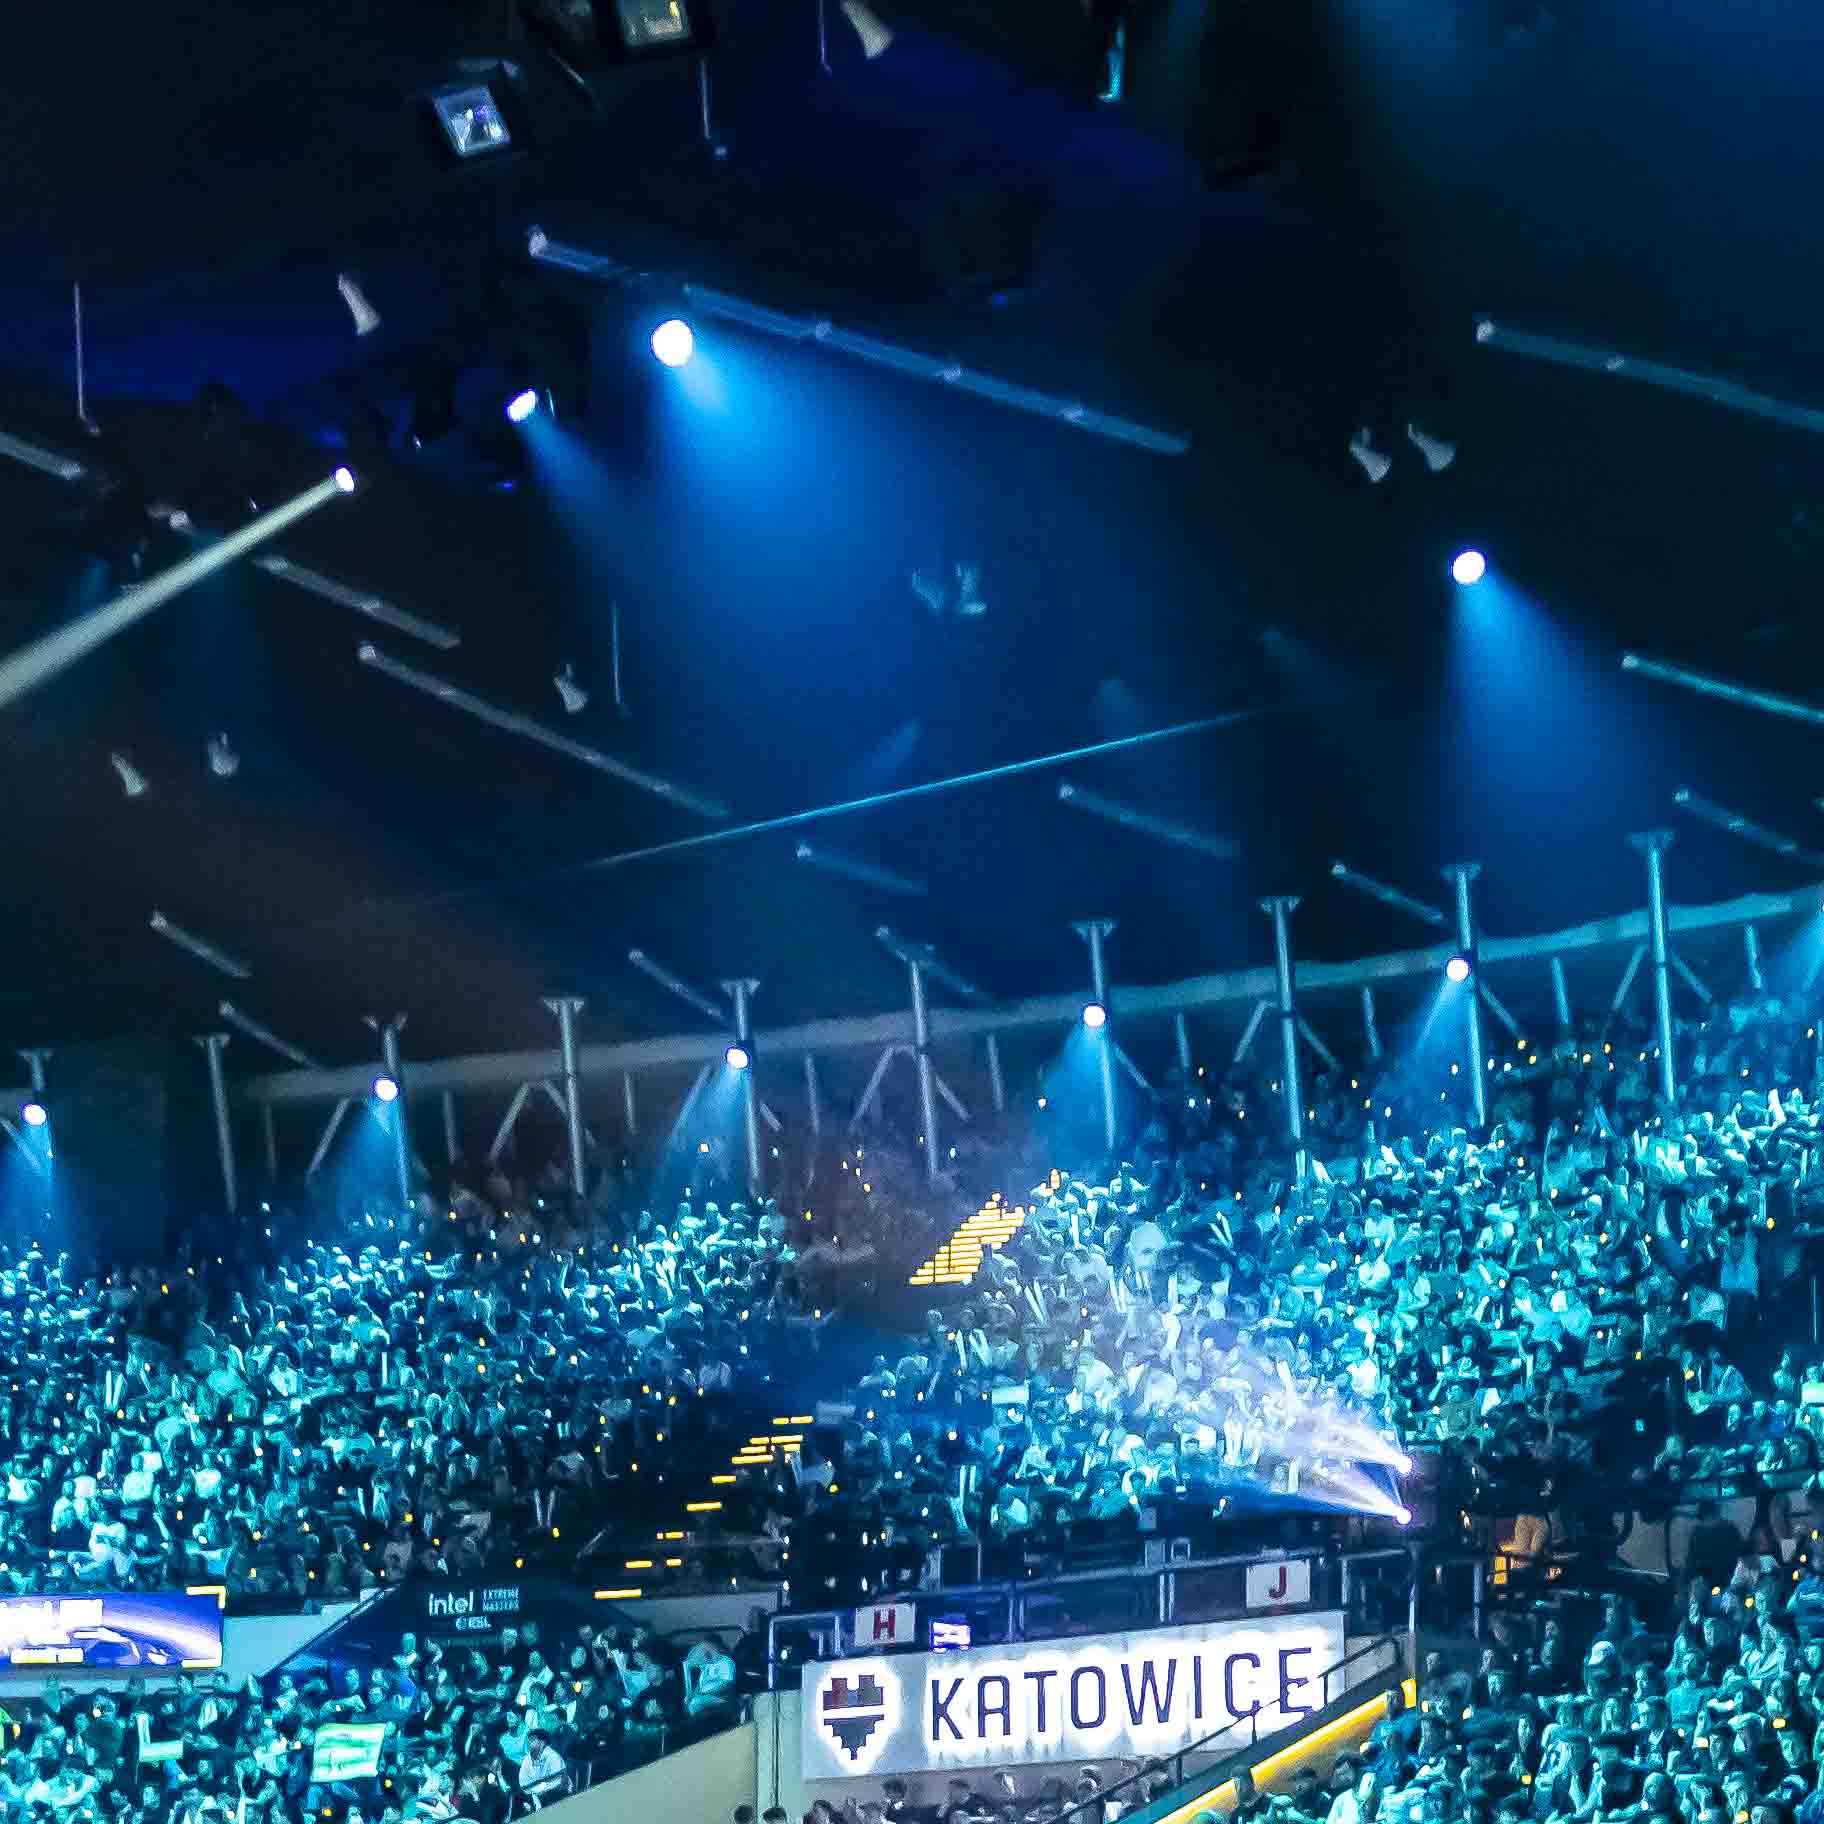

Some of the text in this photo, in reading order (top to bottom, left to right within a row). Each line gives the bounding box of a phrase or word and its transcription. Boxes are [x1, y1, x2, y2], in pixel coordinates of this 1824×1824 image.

[1268, 1566, 1287, 1600] J
[428, 1590, 474, 1616] intel
[872, 1608, 896, 1641] H
[931, 1646, 1314, 1742] KATOWICE
